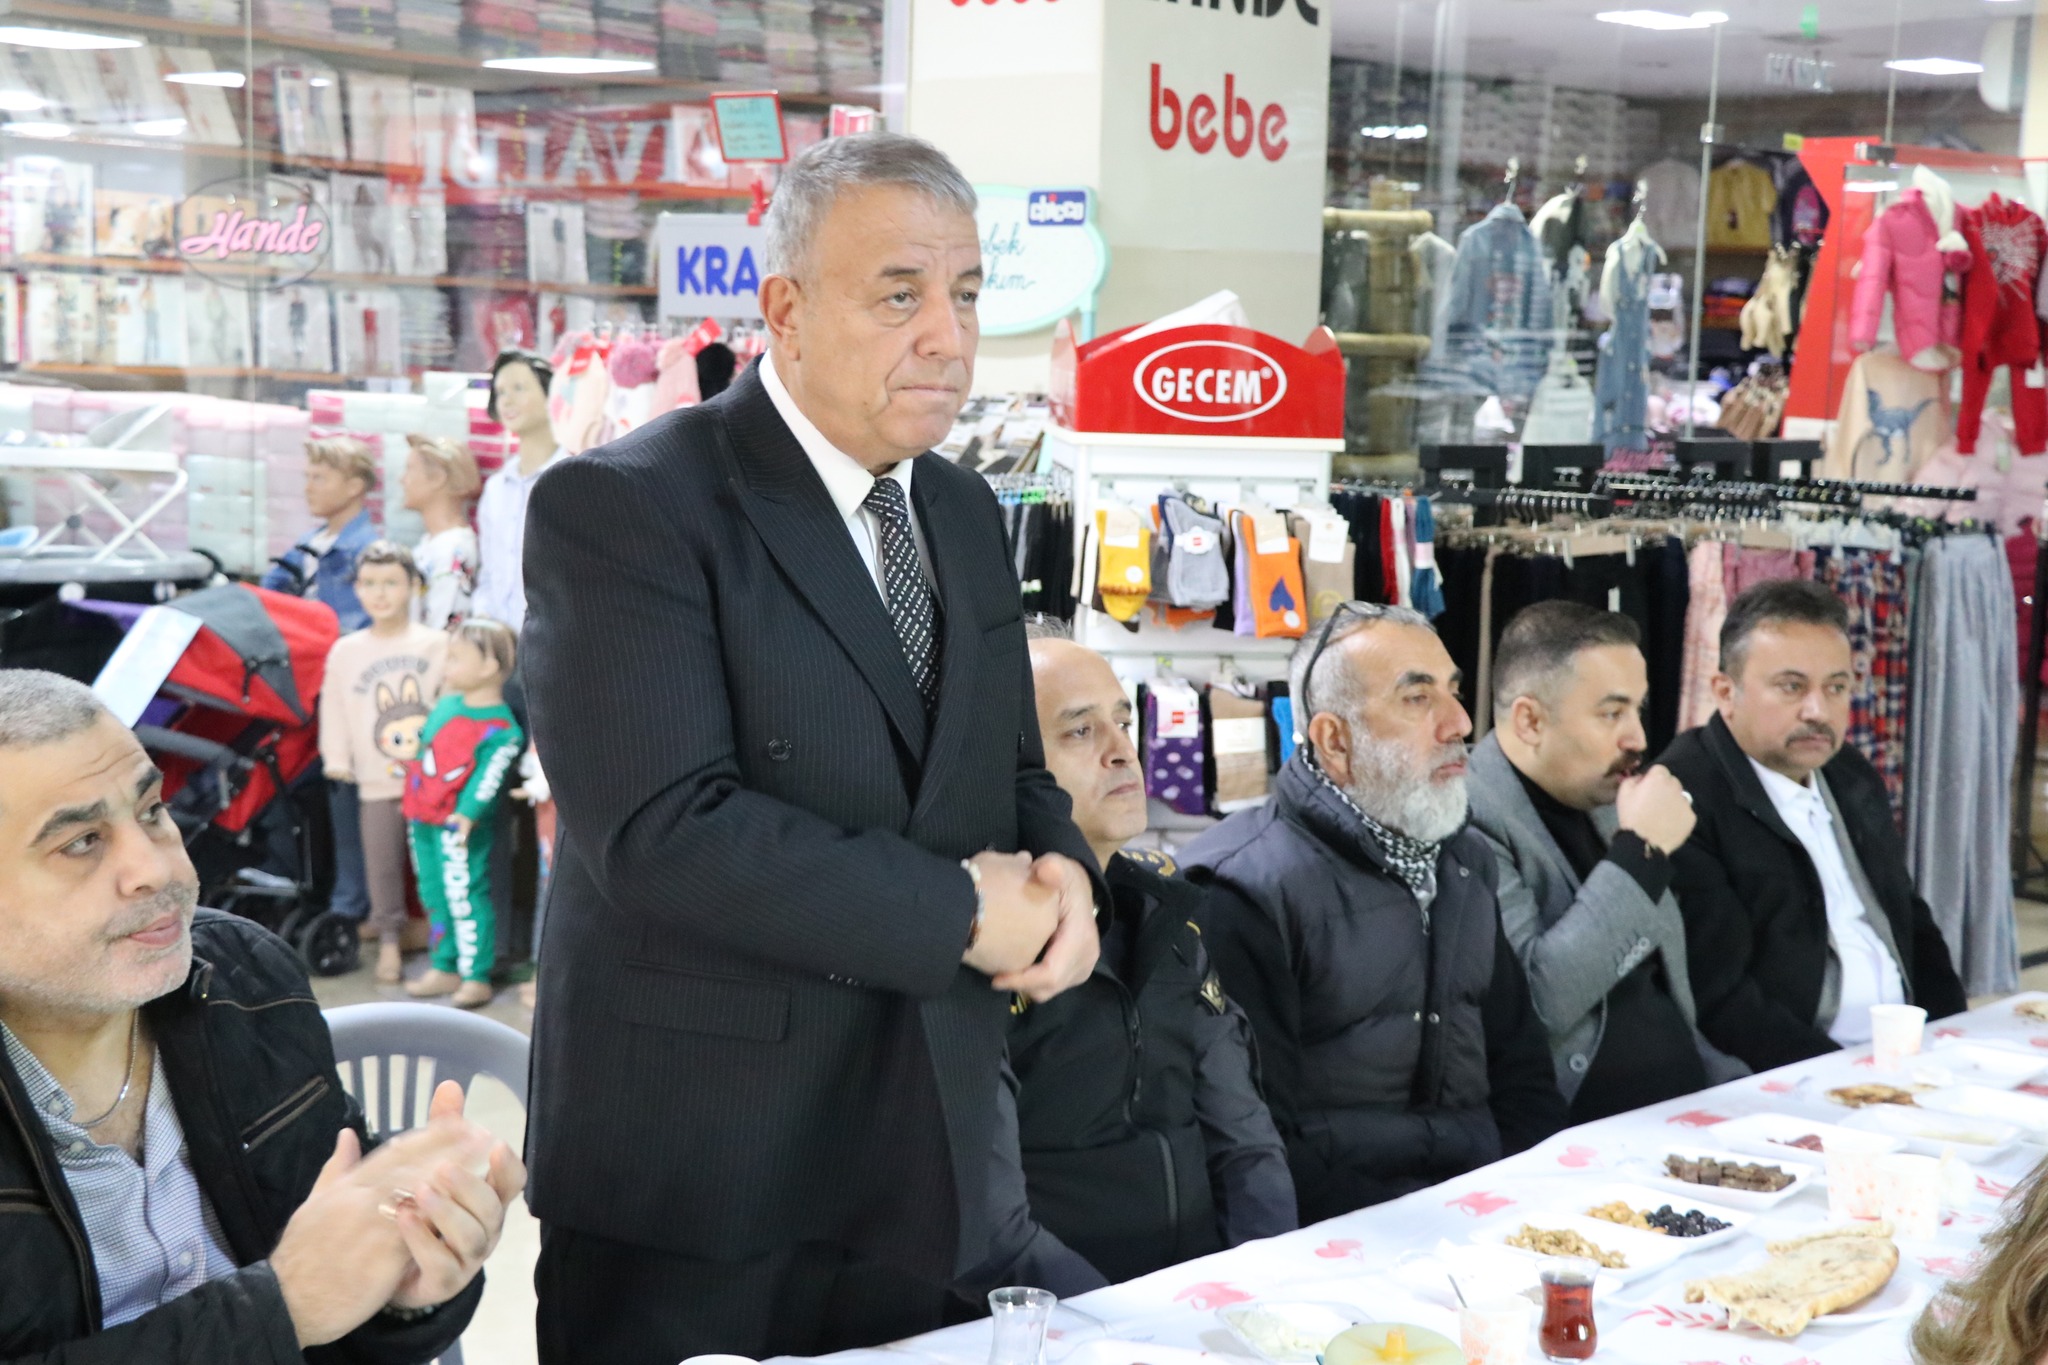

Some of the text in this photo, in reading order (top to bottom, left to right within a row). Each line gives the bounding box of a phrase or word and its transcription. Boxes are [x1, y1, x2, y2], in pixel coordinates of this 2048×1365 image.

[1150, 62, 1289, 162] bebe
[179, 204, 323, 259] Hande
[1029, 193, 1084, 222] chicco
[678, 246, 761, 297] KRA
